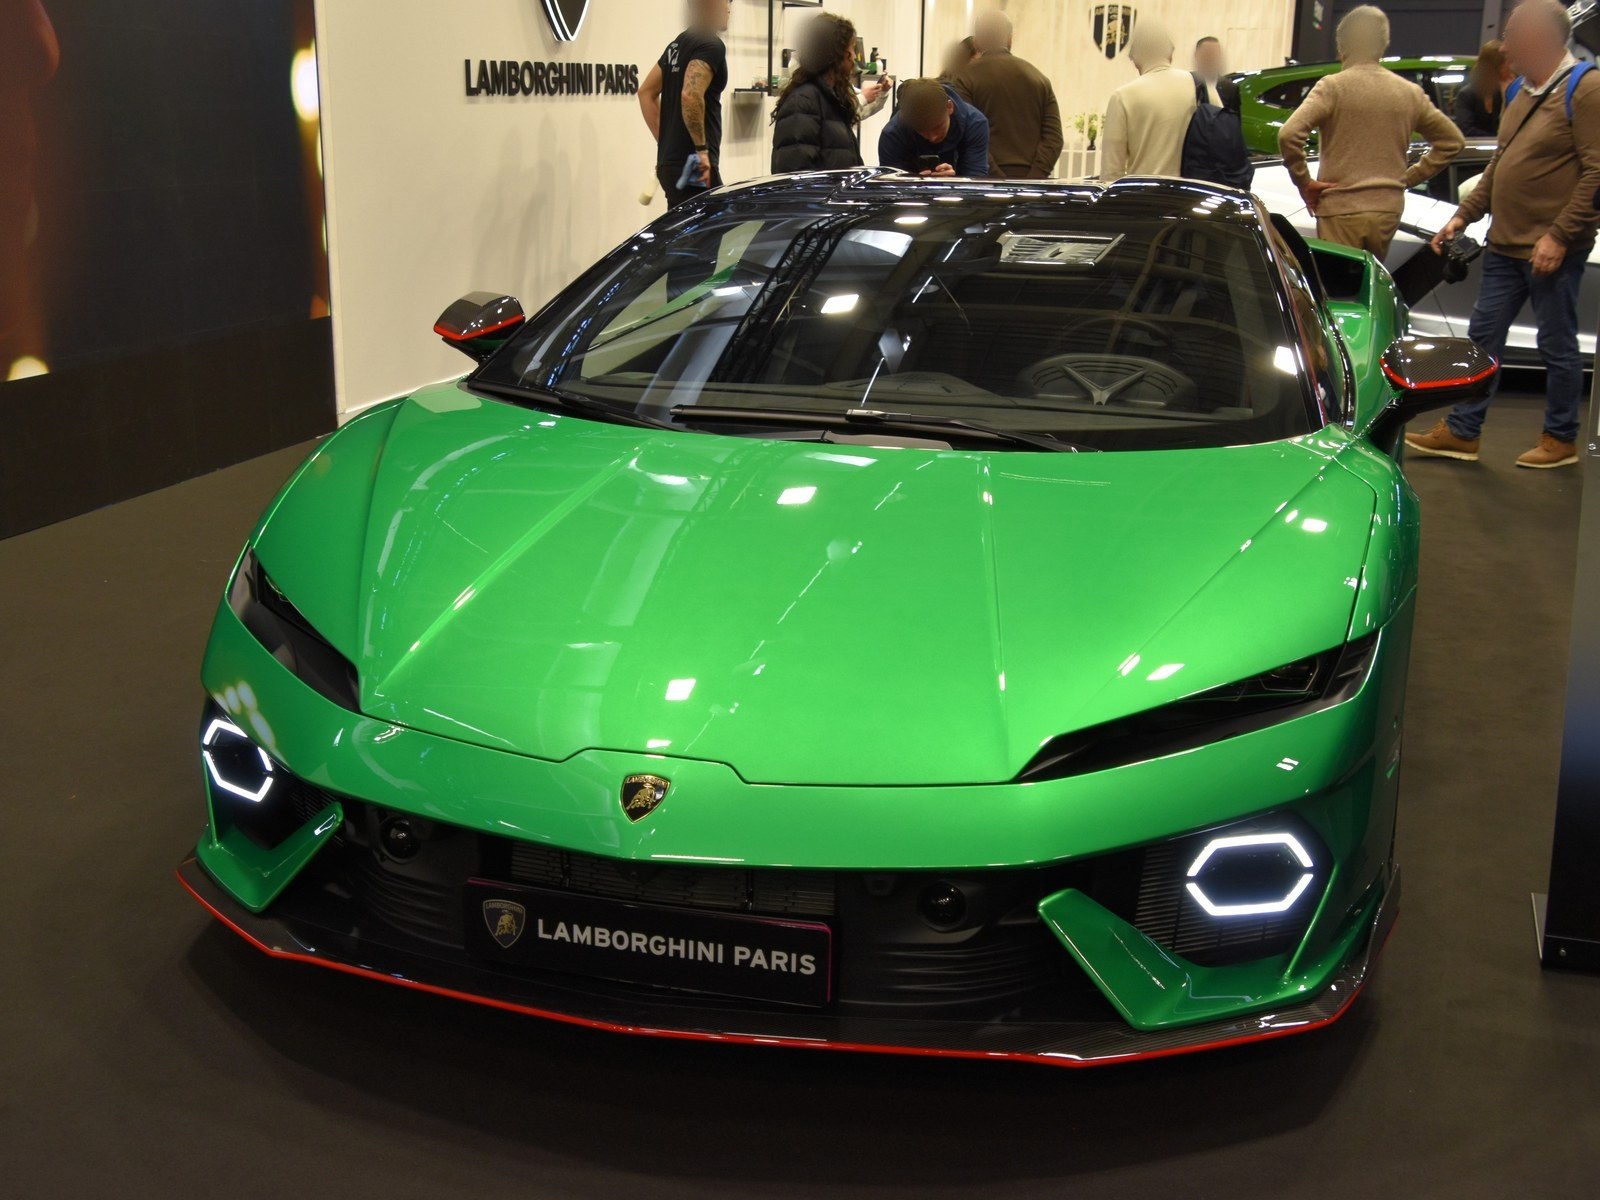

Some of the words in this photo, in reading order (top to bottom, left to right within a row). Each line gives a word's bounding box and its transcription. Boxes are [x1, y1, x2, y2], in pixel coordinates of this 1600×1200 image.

[465, 59, 593, 96] LAMBORGHINI
[596, 64, 639, 95] PARIS
[537, 918, 724, 964] LAMBORGHINI
[734, 946, 817, 976] PARIS
